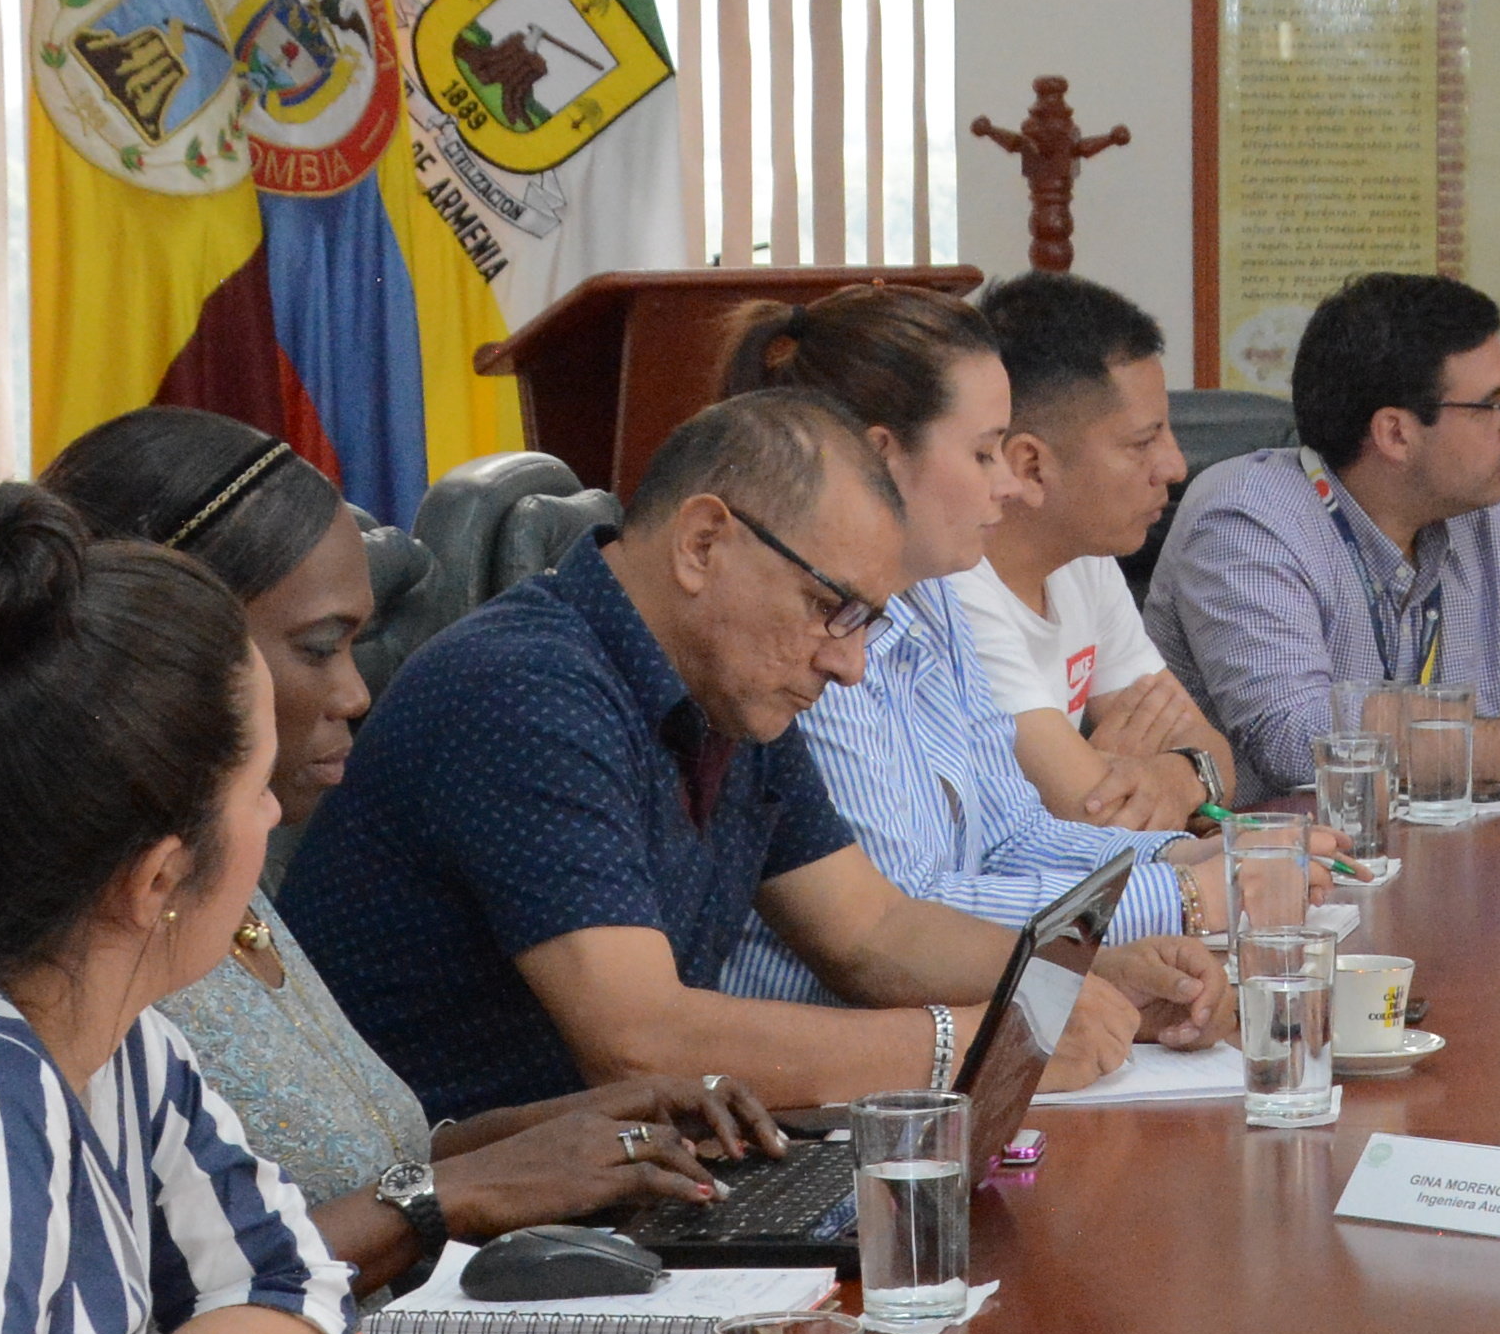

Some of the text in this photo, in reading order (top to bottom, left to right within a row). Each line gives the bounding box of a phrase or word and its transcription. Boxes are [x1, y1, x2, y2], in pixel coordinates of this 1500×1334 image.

[441, 79, 488, 131] 1889
[247, 147, 353, 191] OMBIA
[423, 177, 510, 285] ARMENIA
[1409, 1173, 1444, 1188] GINA
[1416, 1190, 1477, 1211] Ingeniera
